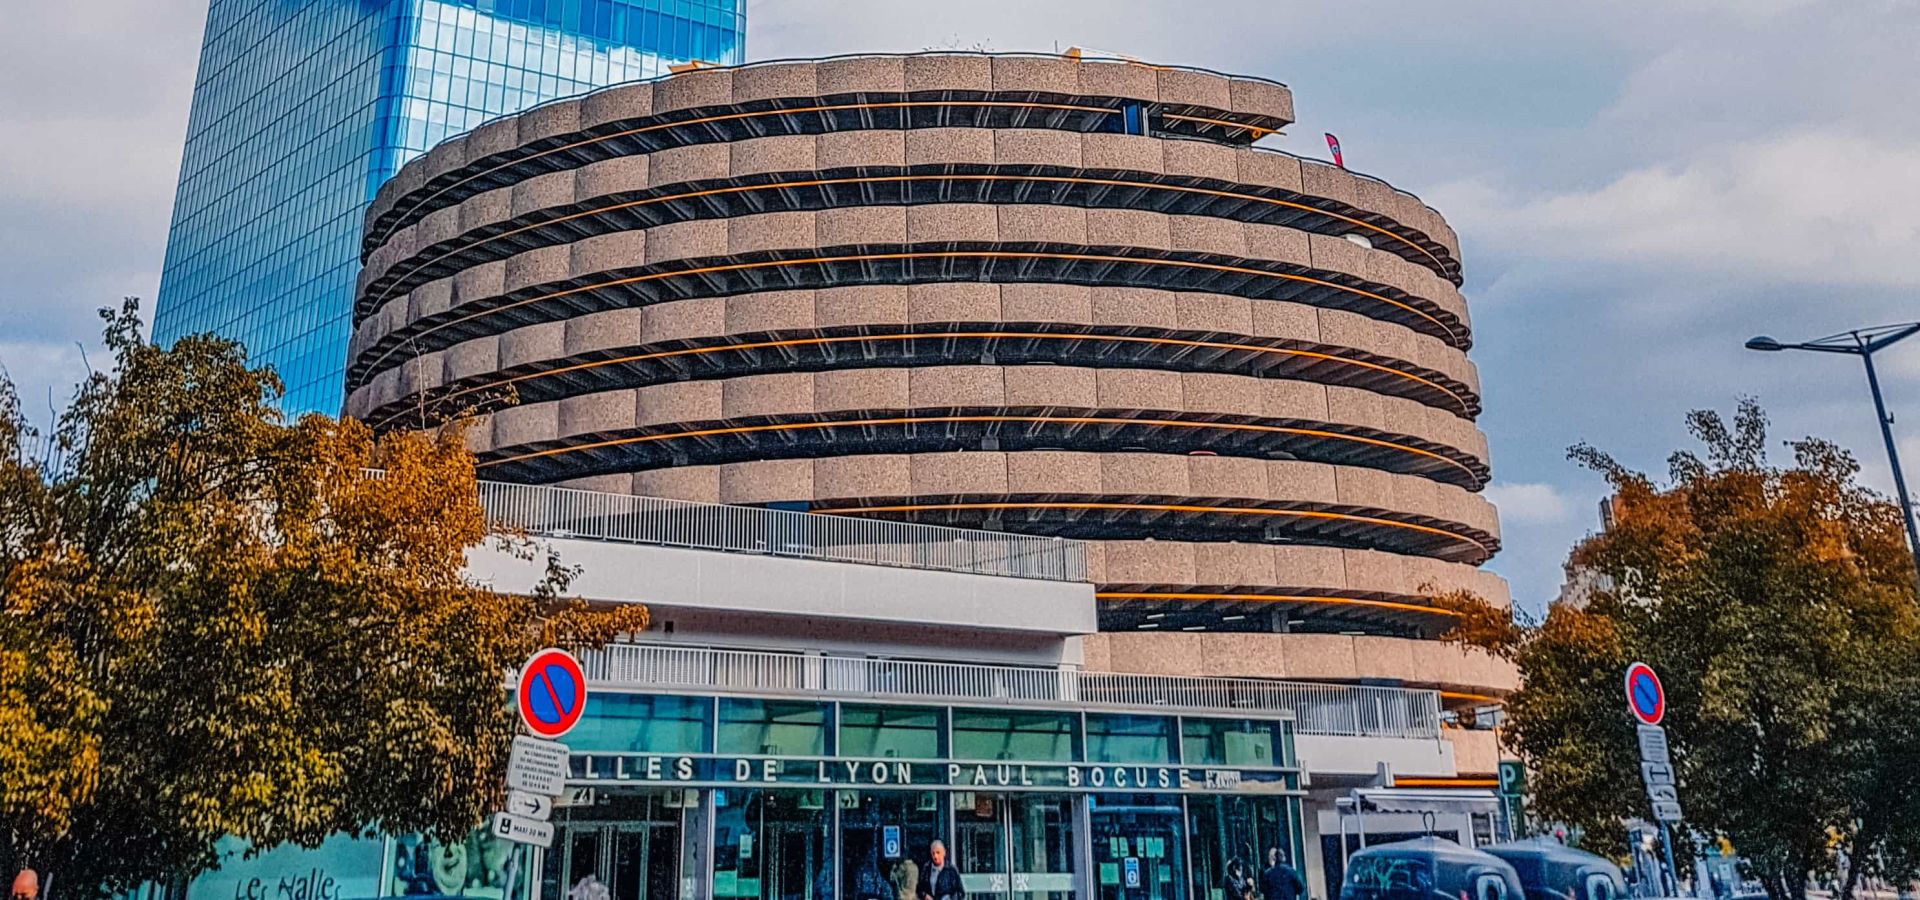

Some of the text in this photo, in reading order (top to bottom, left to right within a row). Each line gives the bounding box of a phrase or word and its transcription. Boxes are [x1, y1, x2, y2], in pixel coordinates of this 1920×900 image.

[735, 758, 778, 782] DE
[818, 760, 912, 785] LYON
[948, 763, 1033, 787] PAUL
[1067, 765, 1191, 789] BOCUSE
[1501, 764, 1517, 791] P
